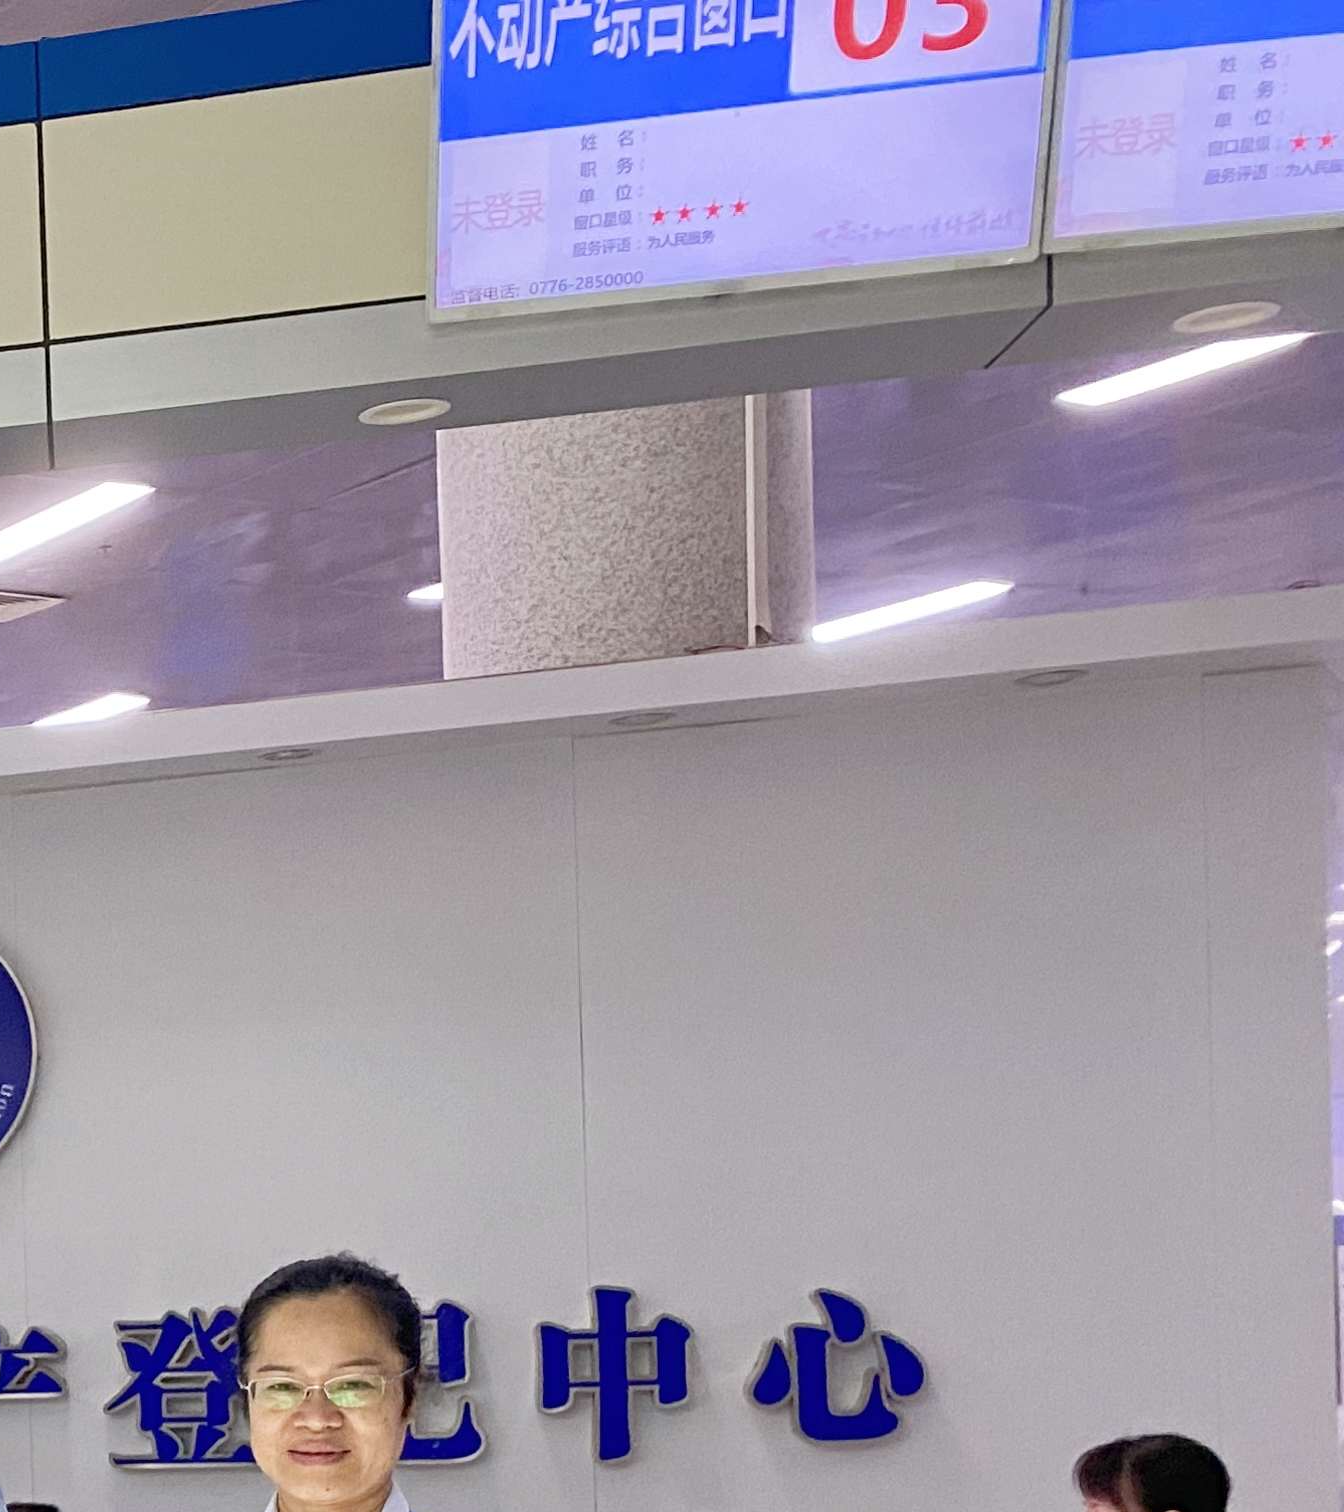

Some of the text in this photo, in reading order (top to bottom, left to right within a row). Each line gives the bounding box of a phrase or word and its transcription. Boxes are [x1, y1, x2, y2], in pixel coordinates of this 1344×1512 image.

[1075, 112, 1178, 160] 未登录
[450, 188, 546, 236] 未登录
[528, 270, 645, 296] 0776-2850000
